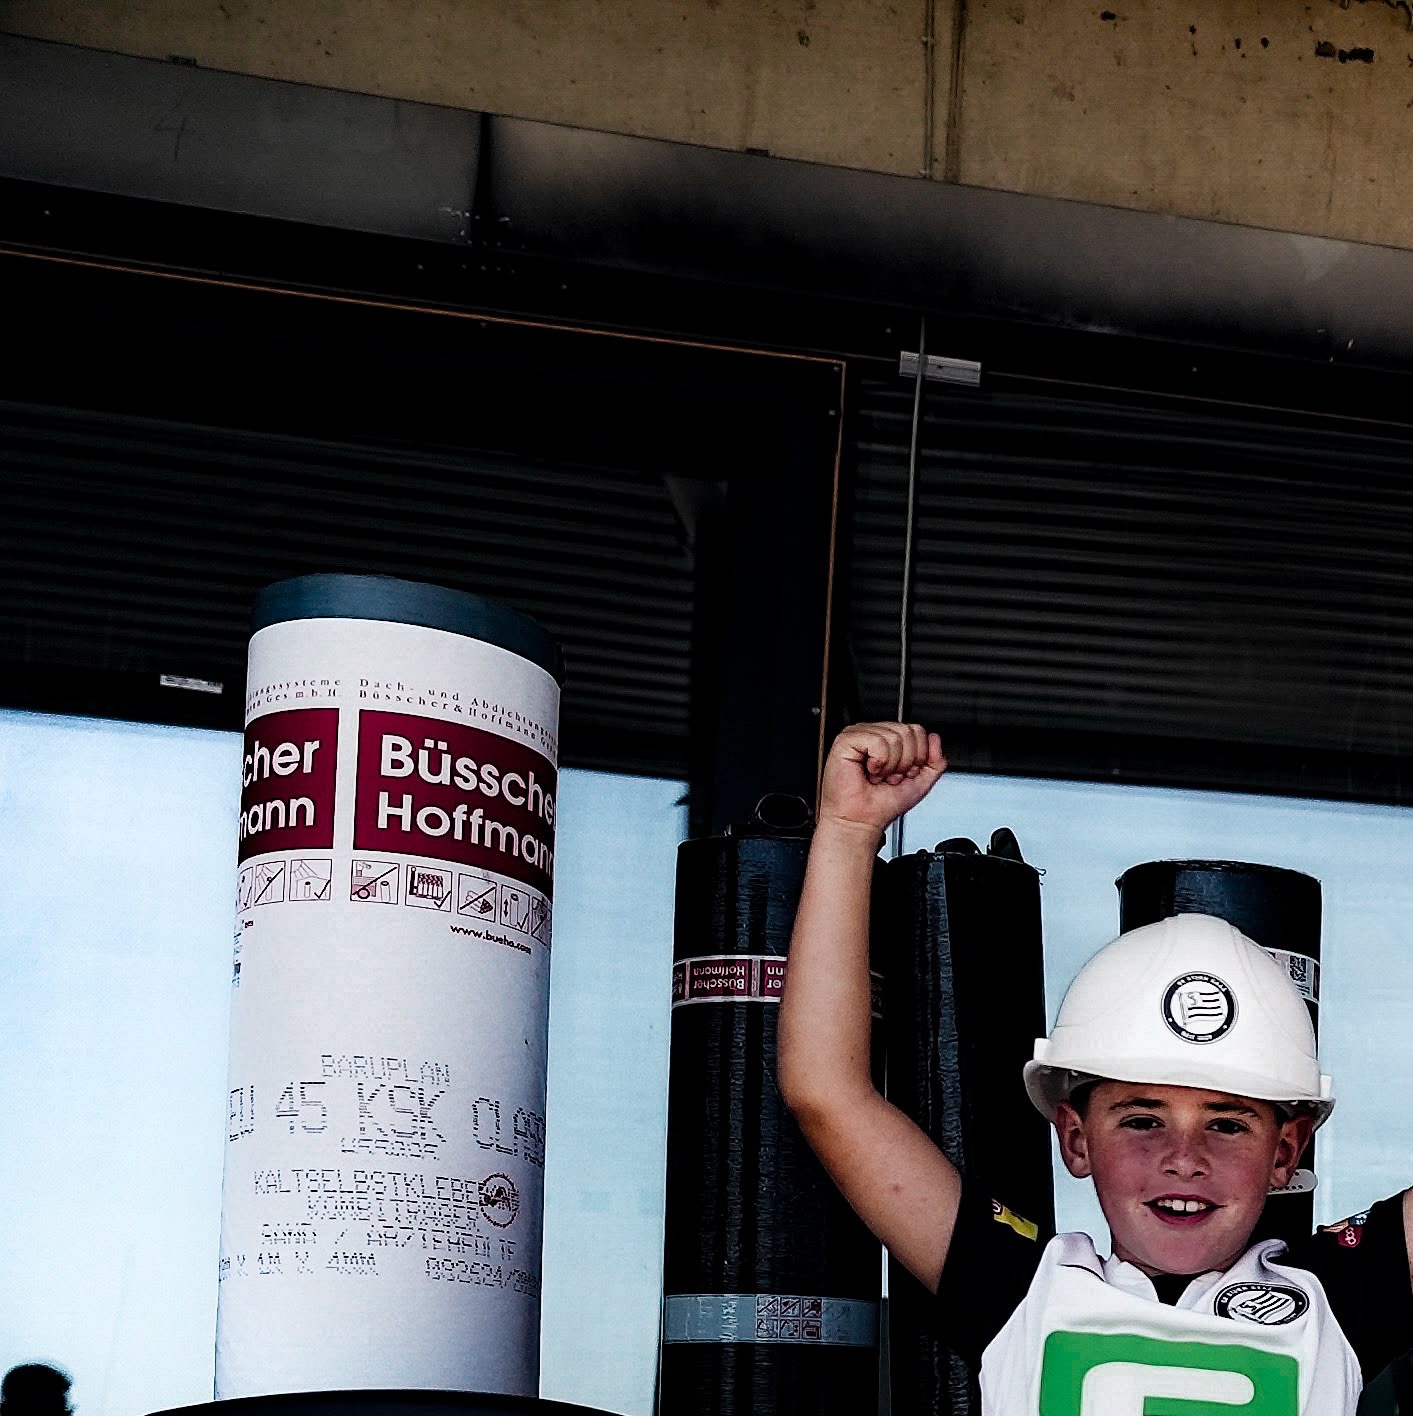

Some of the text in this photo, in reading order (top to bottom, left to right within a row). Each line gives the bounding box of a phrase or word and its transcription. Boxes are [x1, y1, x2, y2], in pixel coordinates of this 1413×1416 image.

[428, 689, 460, 701] und
[320, 1055, 450, 1088] BARUPLAN
[275, 1079, 328, 1134] 45
[356, 1080, 447, 1143] KSK
